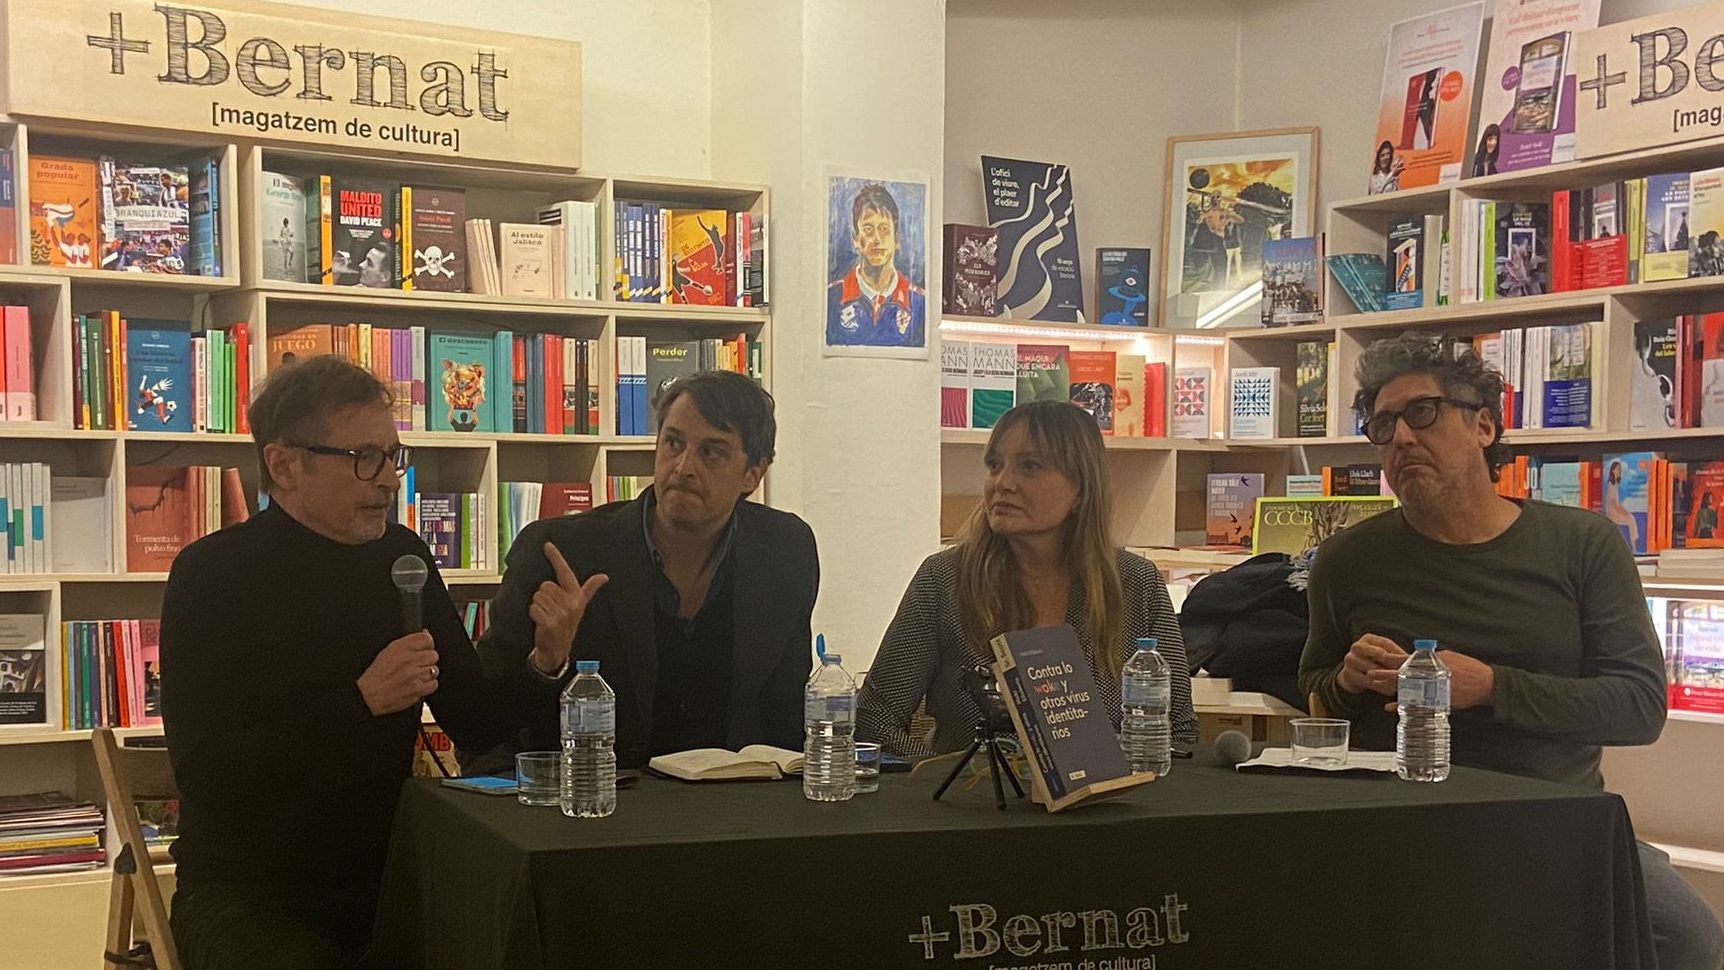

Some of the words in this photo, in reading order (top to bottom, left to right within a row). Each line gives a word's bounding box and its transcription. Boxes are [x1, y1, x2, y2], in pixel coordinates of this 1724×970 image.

[87, 2, 509, 122] +Bernat
[212, 102, 337, 135] [magatzem
[345, 118, 373, 138] de
[379, 122, 461, 151] cultura]
[41, 162, 74, 172] Grada
[37, 171, 80, 181] popular
[992, 178, 1001, 187] de
[340, 190, 382, 205] MALDITO
[340, 202, 382, 218] UNITED
[340, 216, 359, 226] DAVID
[360, 216, 382, 227] PEACE
[273, 339, 316, 353] JUEGO
[652, 347, 688, 357] Perder
[941, 344, 968, 356] OMAS
[974, 346, 1015, 358] THOMAS
[973, 357, 1015, 370] MANN
[1264, 510, 1313, 526] CCCB
[1027, 665, 1062, 680] Contra
[1060, 660, 1073, 674] lo
[1033, 679, 1060, 694] woke
[1060, 680, 1068, 693] y
[1040, 696, 1067, 710] otros
[1066, 691, 1090, 704] virus
[1044, 707, 1089, 725] identita-
[1051, 726, 1071, 740] rios
[908, 892, 1190, 959] +Bernat
[1099, 954, 1157, 970] cultura]
